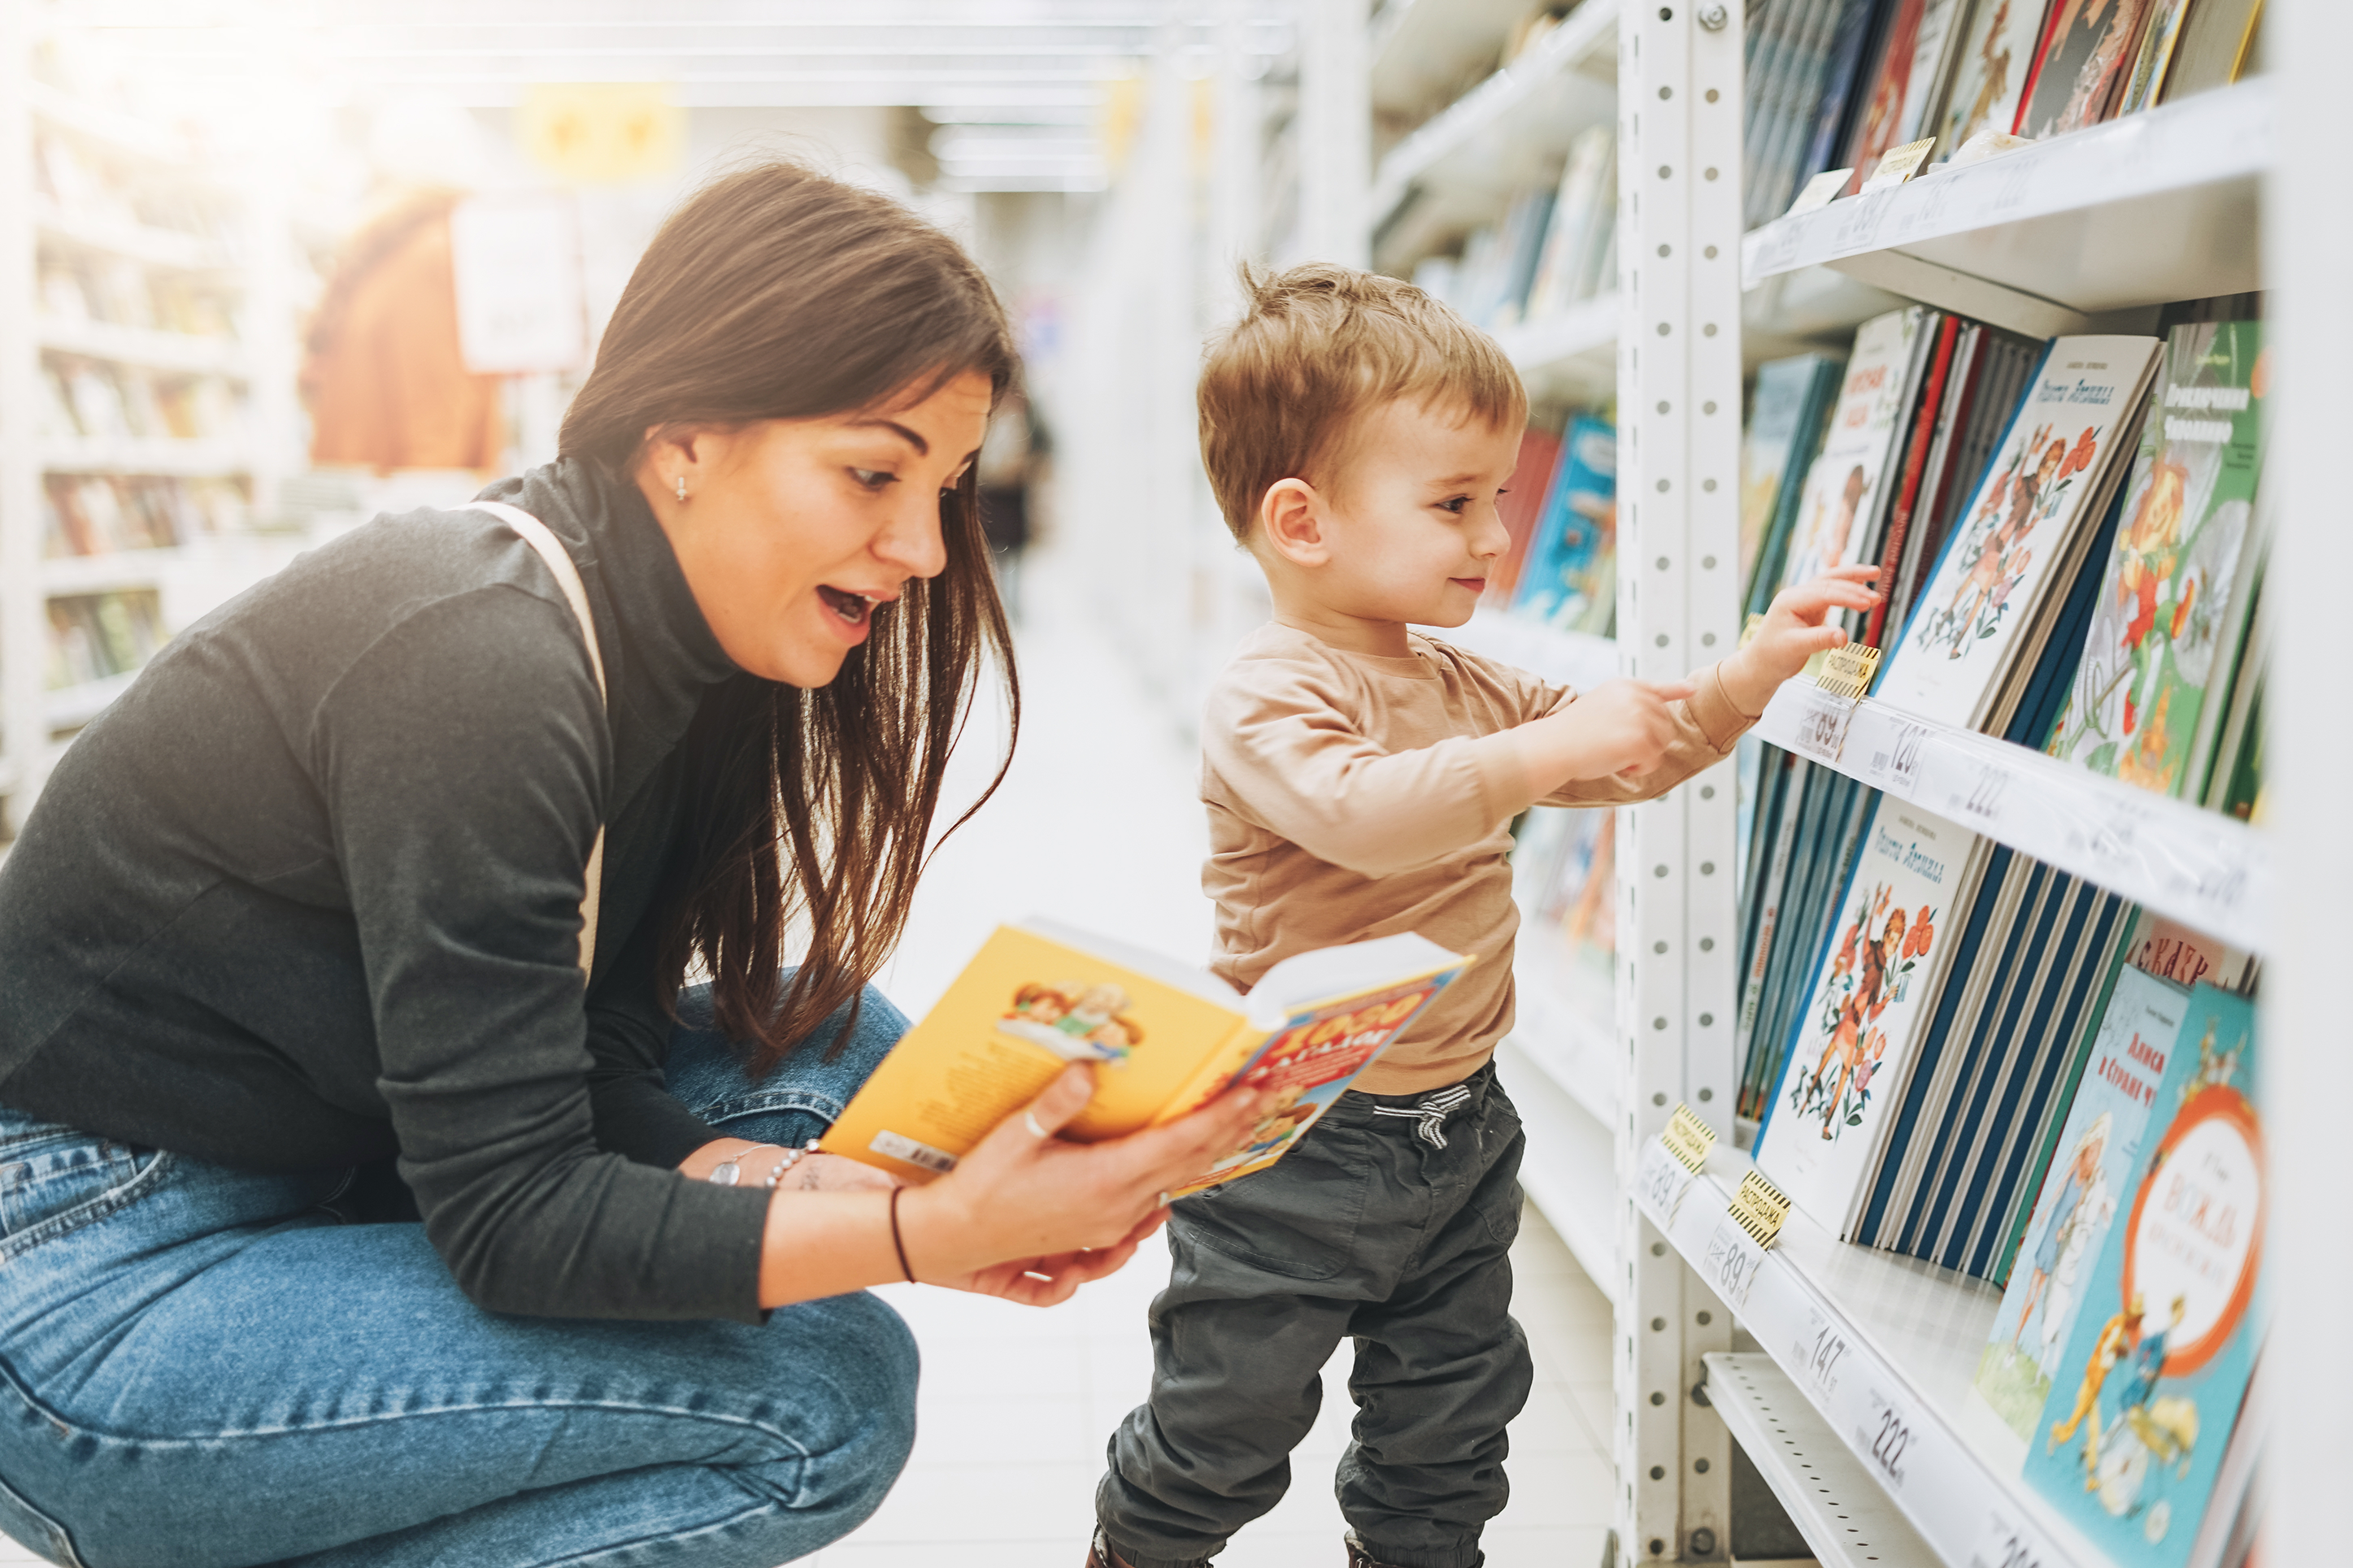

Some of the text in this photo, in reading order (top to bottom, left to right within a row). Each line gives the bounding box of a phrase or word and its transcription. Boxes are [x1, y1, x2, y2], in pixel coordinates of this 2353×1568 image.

[1826, 654, 1871, 680] РАСПРОДАЖА
[1890, 723, 1928, 775] 120
[1672, 1117, 1707, 1158] РАСПРОДАЖА
[1652, 1163, 1676, 1208] 89
[1739, 1184, 1781, 1228] РАСПРОДАЖА
[2163, 1171, 2238, 1250] ВОЖДЬ
[1720, 1242, 1746, 1297] 89
[1810, 1325, 1846, 1385] 147
[1872, 1408, 1910, 1479] 222
